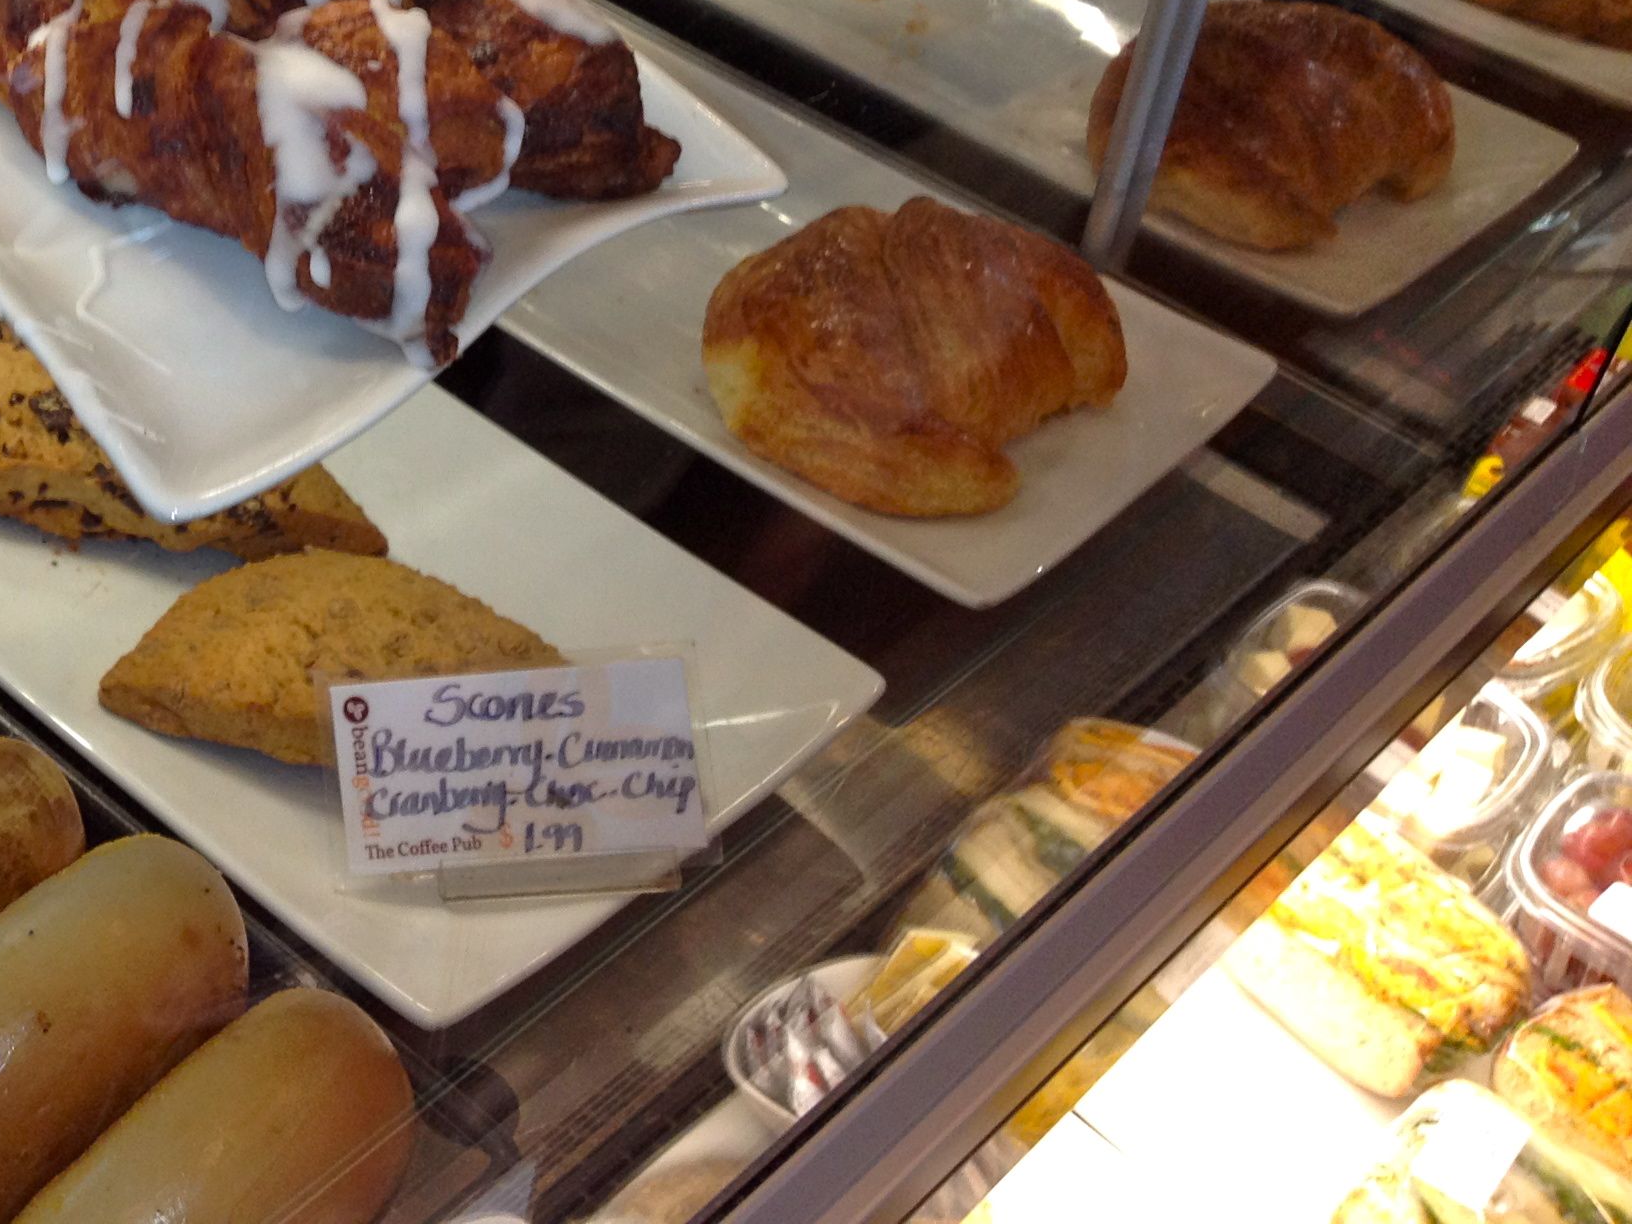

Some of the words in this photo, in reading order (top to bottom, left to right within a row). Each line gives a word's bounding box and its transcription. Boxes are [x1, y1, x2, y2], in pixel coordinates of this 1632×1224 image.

[423, 682, 587, 727] Scones
[620, 762, 697, 815] Chip
[365, 844, 395, 861] The
[397, 839, 449, 858] Coffee
[452, 833, 483, 853] Pub
